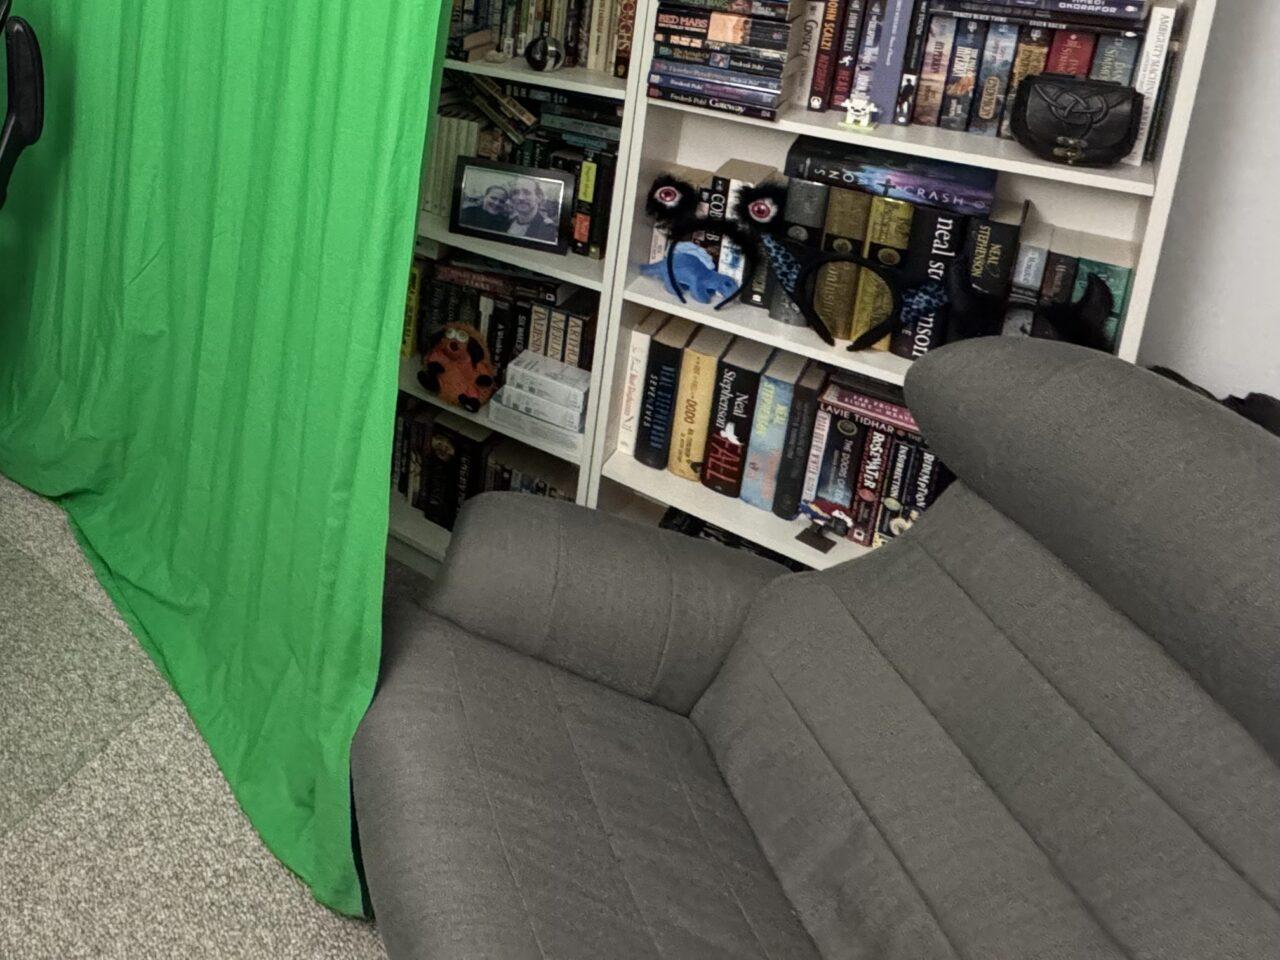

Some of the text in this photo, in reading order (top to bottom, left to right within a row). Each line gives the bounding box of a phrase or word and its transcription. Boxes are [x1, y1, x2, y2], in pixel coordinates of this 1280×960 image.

[658, 14, 679, 25] RED
[679, 16, 709, 29] MARS
[819, 22, 835, 51] SCALZI
[843, 12, 859, 52] JOHN SCALZI
[835, 70, 851, 92] HEAD
[904, 185, 965, 206] CRASH
[931, 217, 956, 258] neal
[970, 225, 992, 279] STEPHENSON
[986, 243, 1003, 265] NEAL
[715, 368, 737, 430] Stephenson
[732, 392, 750, 419] Neal
[820, 403, 895, 434] LAVIE TIDHAR
[706, 432, 744, 484] FALL
[863, 431, 886, 489] ROSEWATER
[889, 444, 909, 500] INSURRECTION
